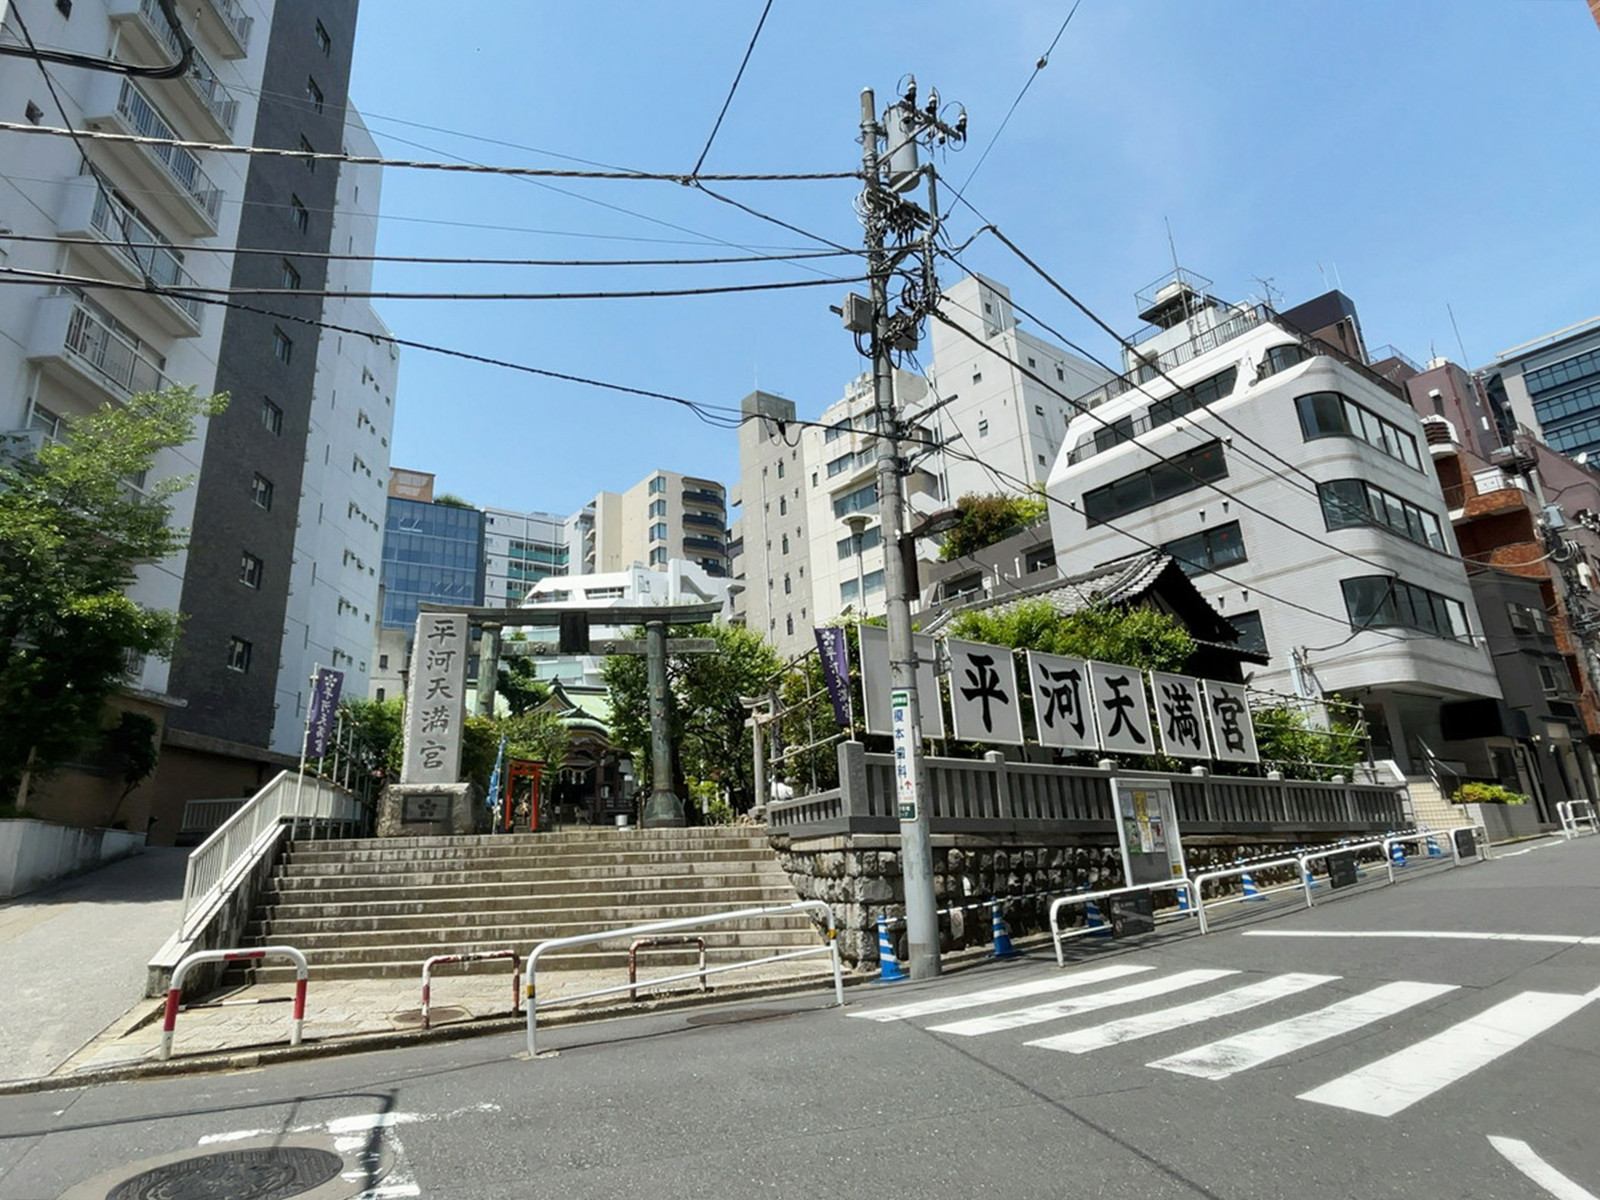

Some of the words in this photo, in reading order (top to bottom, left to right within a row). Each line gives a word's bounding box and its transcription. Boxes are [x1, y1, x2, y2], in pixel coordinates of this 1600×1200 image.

[420, 619, 457, 770] 平河天満宮
[960, 652, 1246, 754] 平河天満宮
